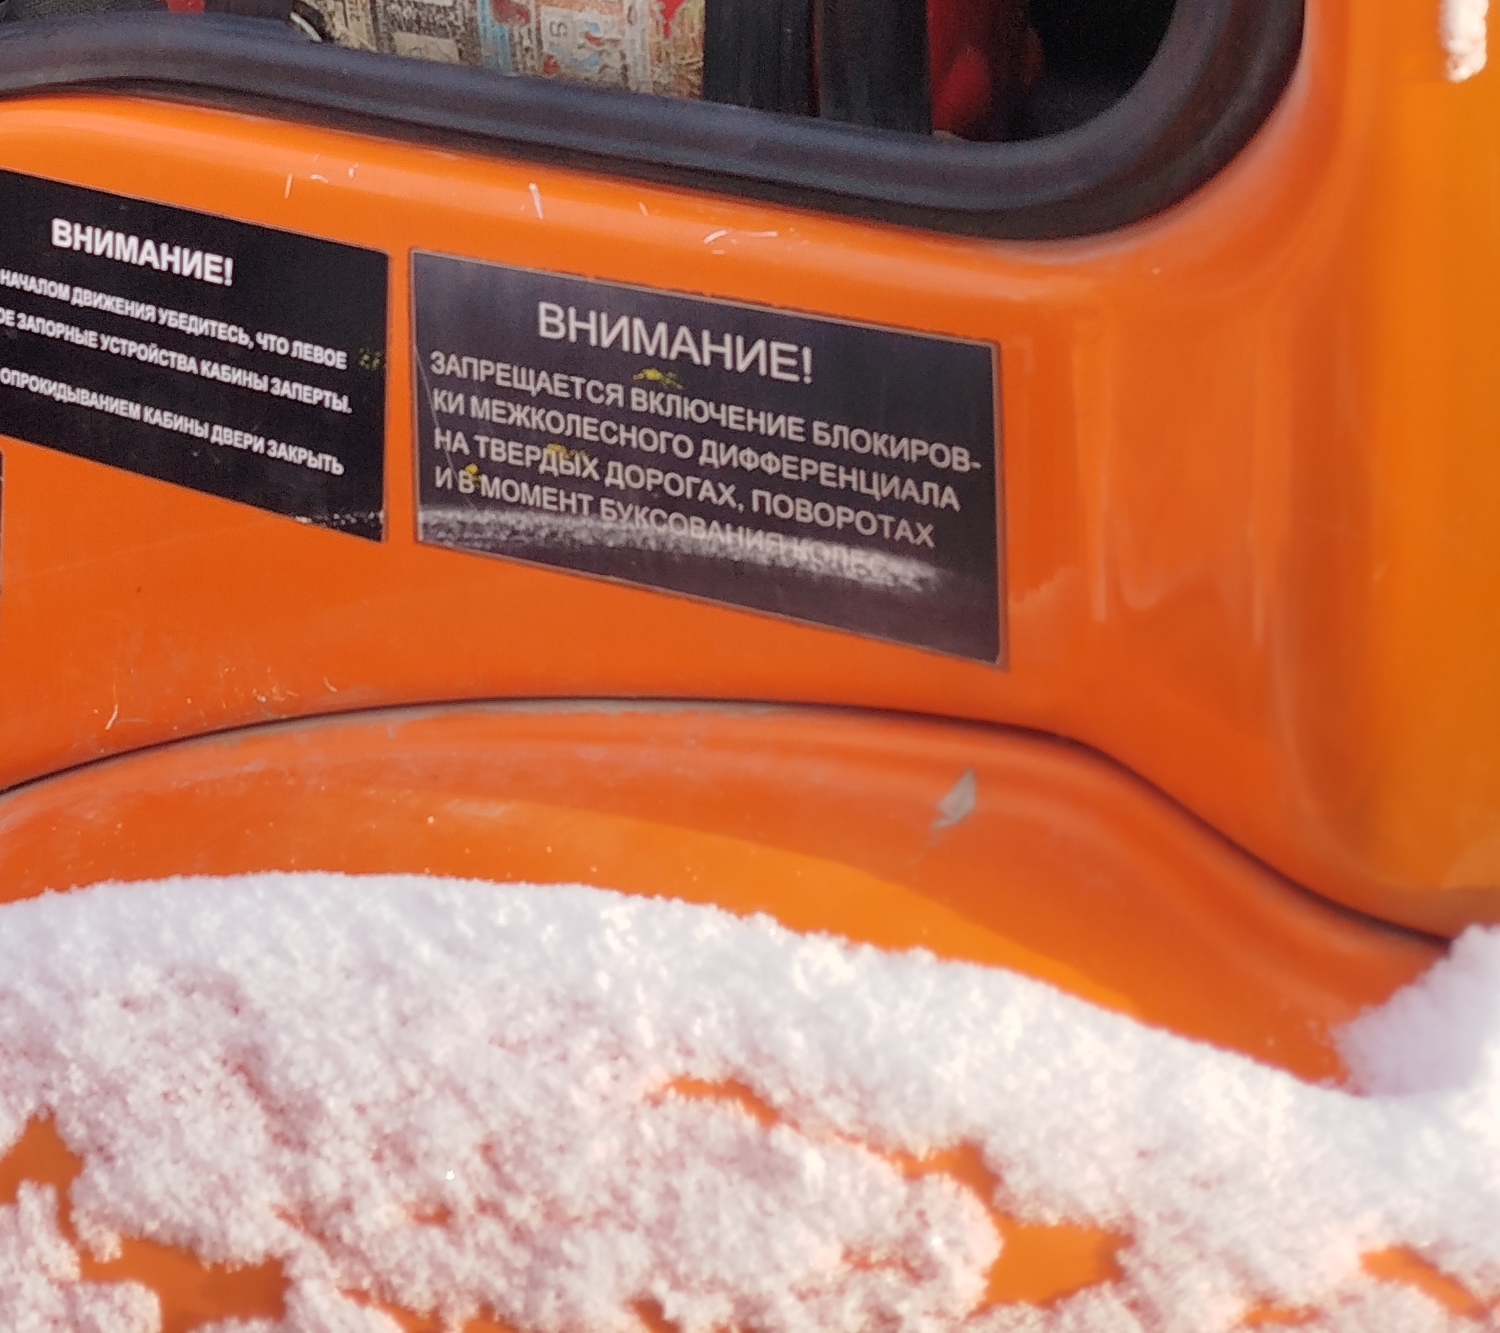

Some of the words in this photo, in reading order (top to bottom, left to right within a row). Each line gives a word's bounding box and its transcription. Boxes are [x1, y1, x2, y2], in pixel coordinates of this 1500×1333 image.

[51, 217, 234, 287] ВНИМАНИЕ!
[0, 269, 71, 301] НАЧАЛОМ
[71, 286, 157, 323] ДВИЖЕНИЯ
[158, 307, 255, 350] УБЕДИТЕСЬ,
[255, 331, 290, 355] ЧТО
[290, 340, 348, 370] ЛЕВОЕ
[16, 312, 99, 349] ЗАПОРНЫЕ
[99, 333, 199, 375] УСТРОЙСТВА
[200, 359, 269, 393] КАБИНЫ
[269, 377, 353, 414] ЗАПЕРТЫ.
[538, 301, 813, 385] ВНИМАНИЕ!
[0, 367, 142, 421] ОПРОКИДЫВАНИЕМ
[143, 405, 210, 439] КАБИНЫ
[210, 424, 265, 454] ДВЕРИ
[266, 440, 345, 476] ЗАКРЫТЬ
[430, 349, 625, 408] ЗАПРЕЩАЕТСЯ
[630, 387, 807, 443] ВКЛЮЧЕНИЕ
[812, 419, 982, 473] БЛОКИРОВ-
[433, 388, 465, 416] КИ
[470, 395, 695, 460] МЕЖКОЛЕСНОГО
[699, 437, 962, 513] ДИФФЕРЕНЦИАЛА
[434, 426, 471, 456] НА
[474, 433, 601, 483] ТВЕРДЫХ
[604, 460, 745, 514] ДОРОГАХ,
[751, 488, 936, 548] ПОВОРОТАХ
[434, 465, 452, 490] И
[457, 469, 476, 495] В
[480, 473, 595, 517] МОМЕНТ
